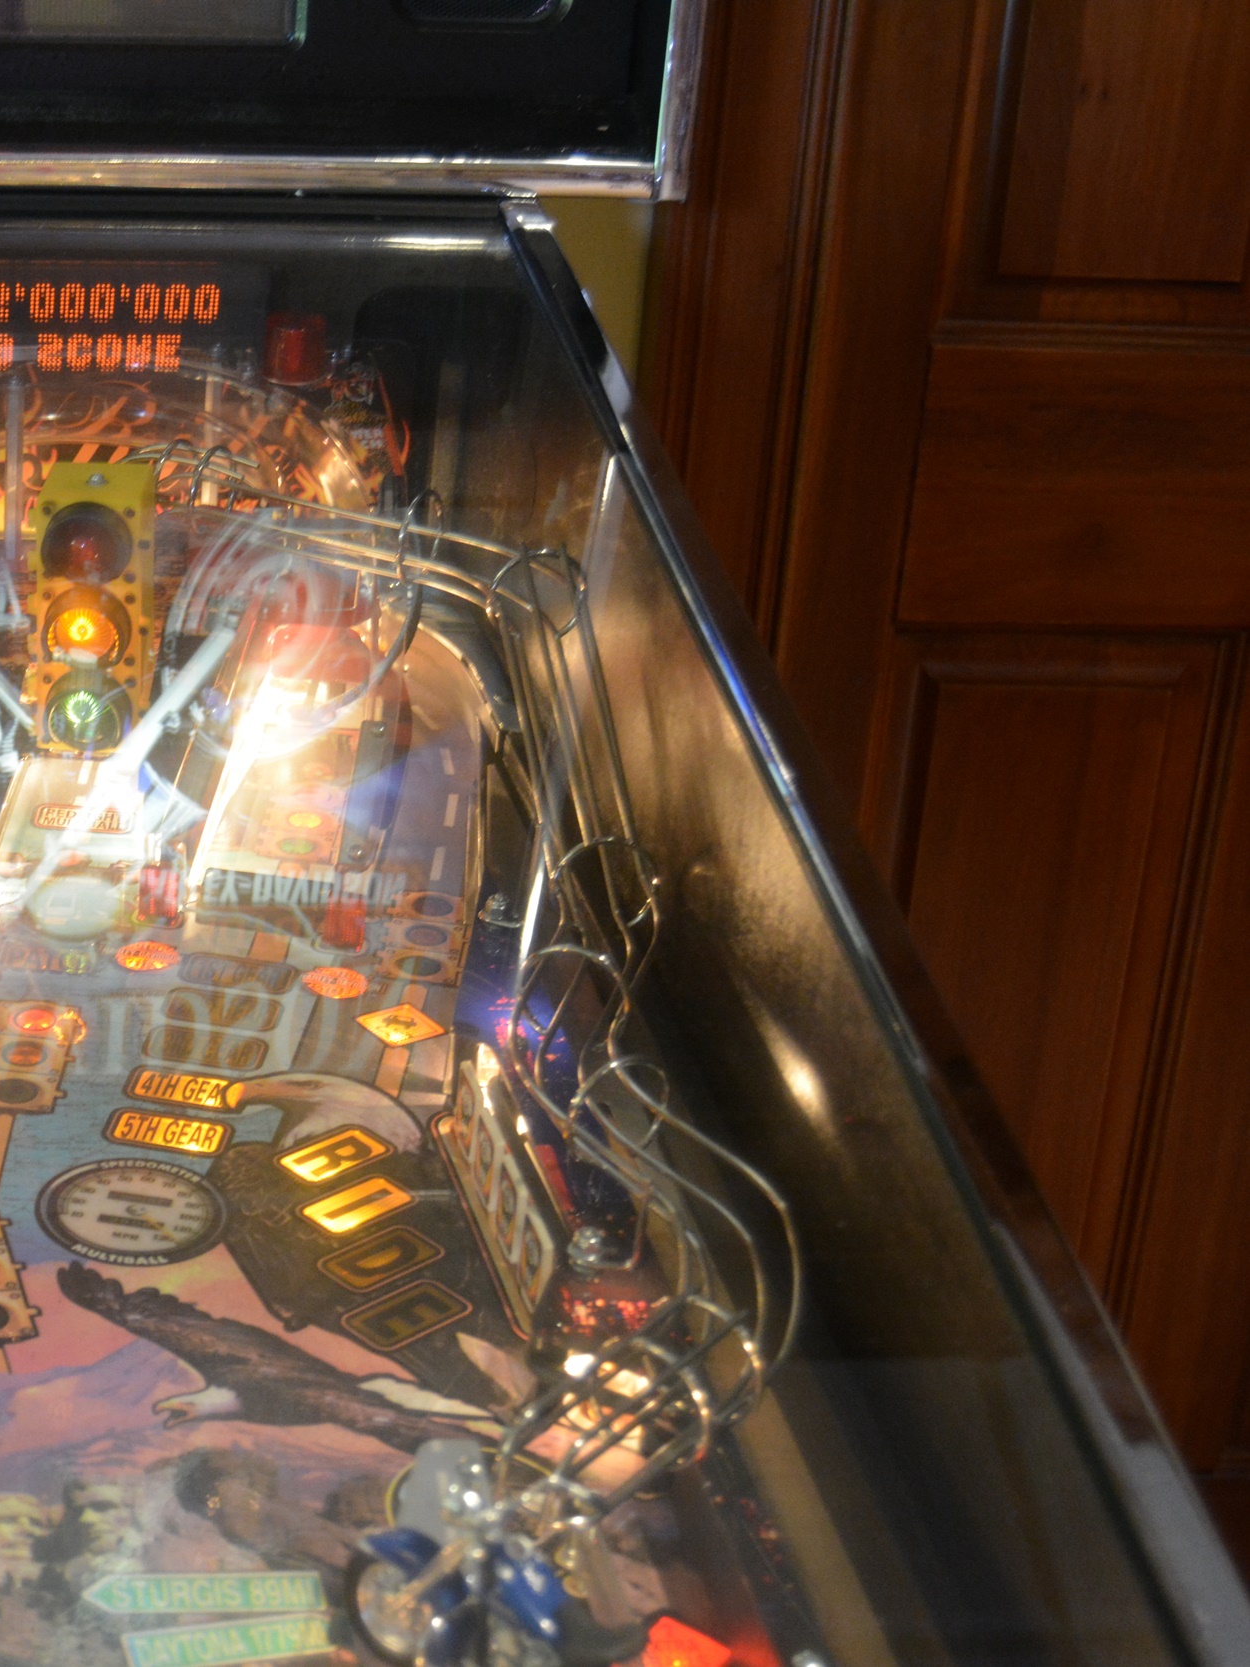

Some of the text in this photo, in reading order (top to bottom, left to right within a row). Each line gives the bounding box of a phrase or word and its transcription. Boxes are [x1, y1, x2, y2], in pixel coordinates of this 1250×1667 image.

[141, 1071, 181, 1097] 4TH
[121, 1113, 217, 1151] 5TH GEAR
[100, 1159, 201, 1183] SPEEDOMETER
[71, 1244, 169, 1265] MULTIBALL
[111, 1577, 244, 1608] STURGIS
